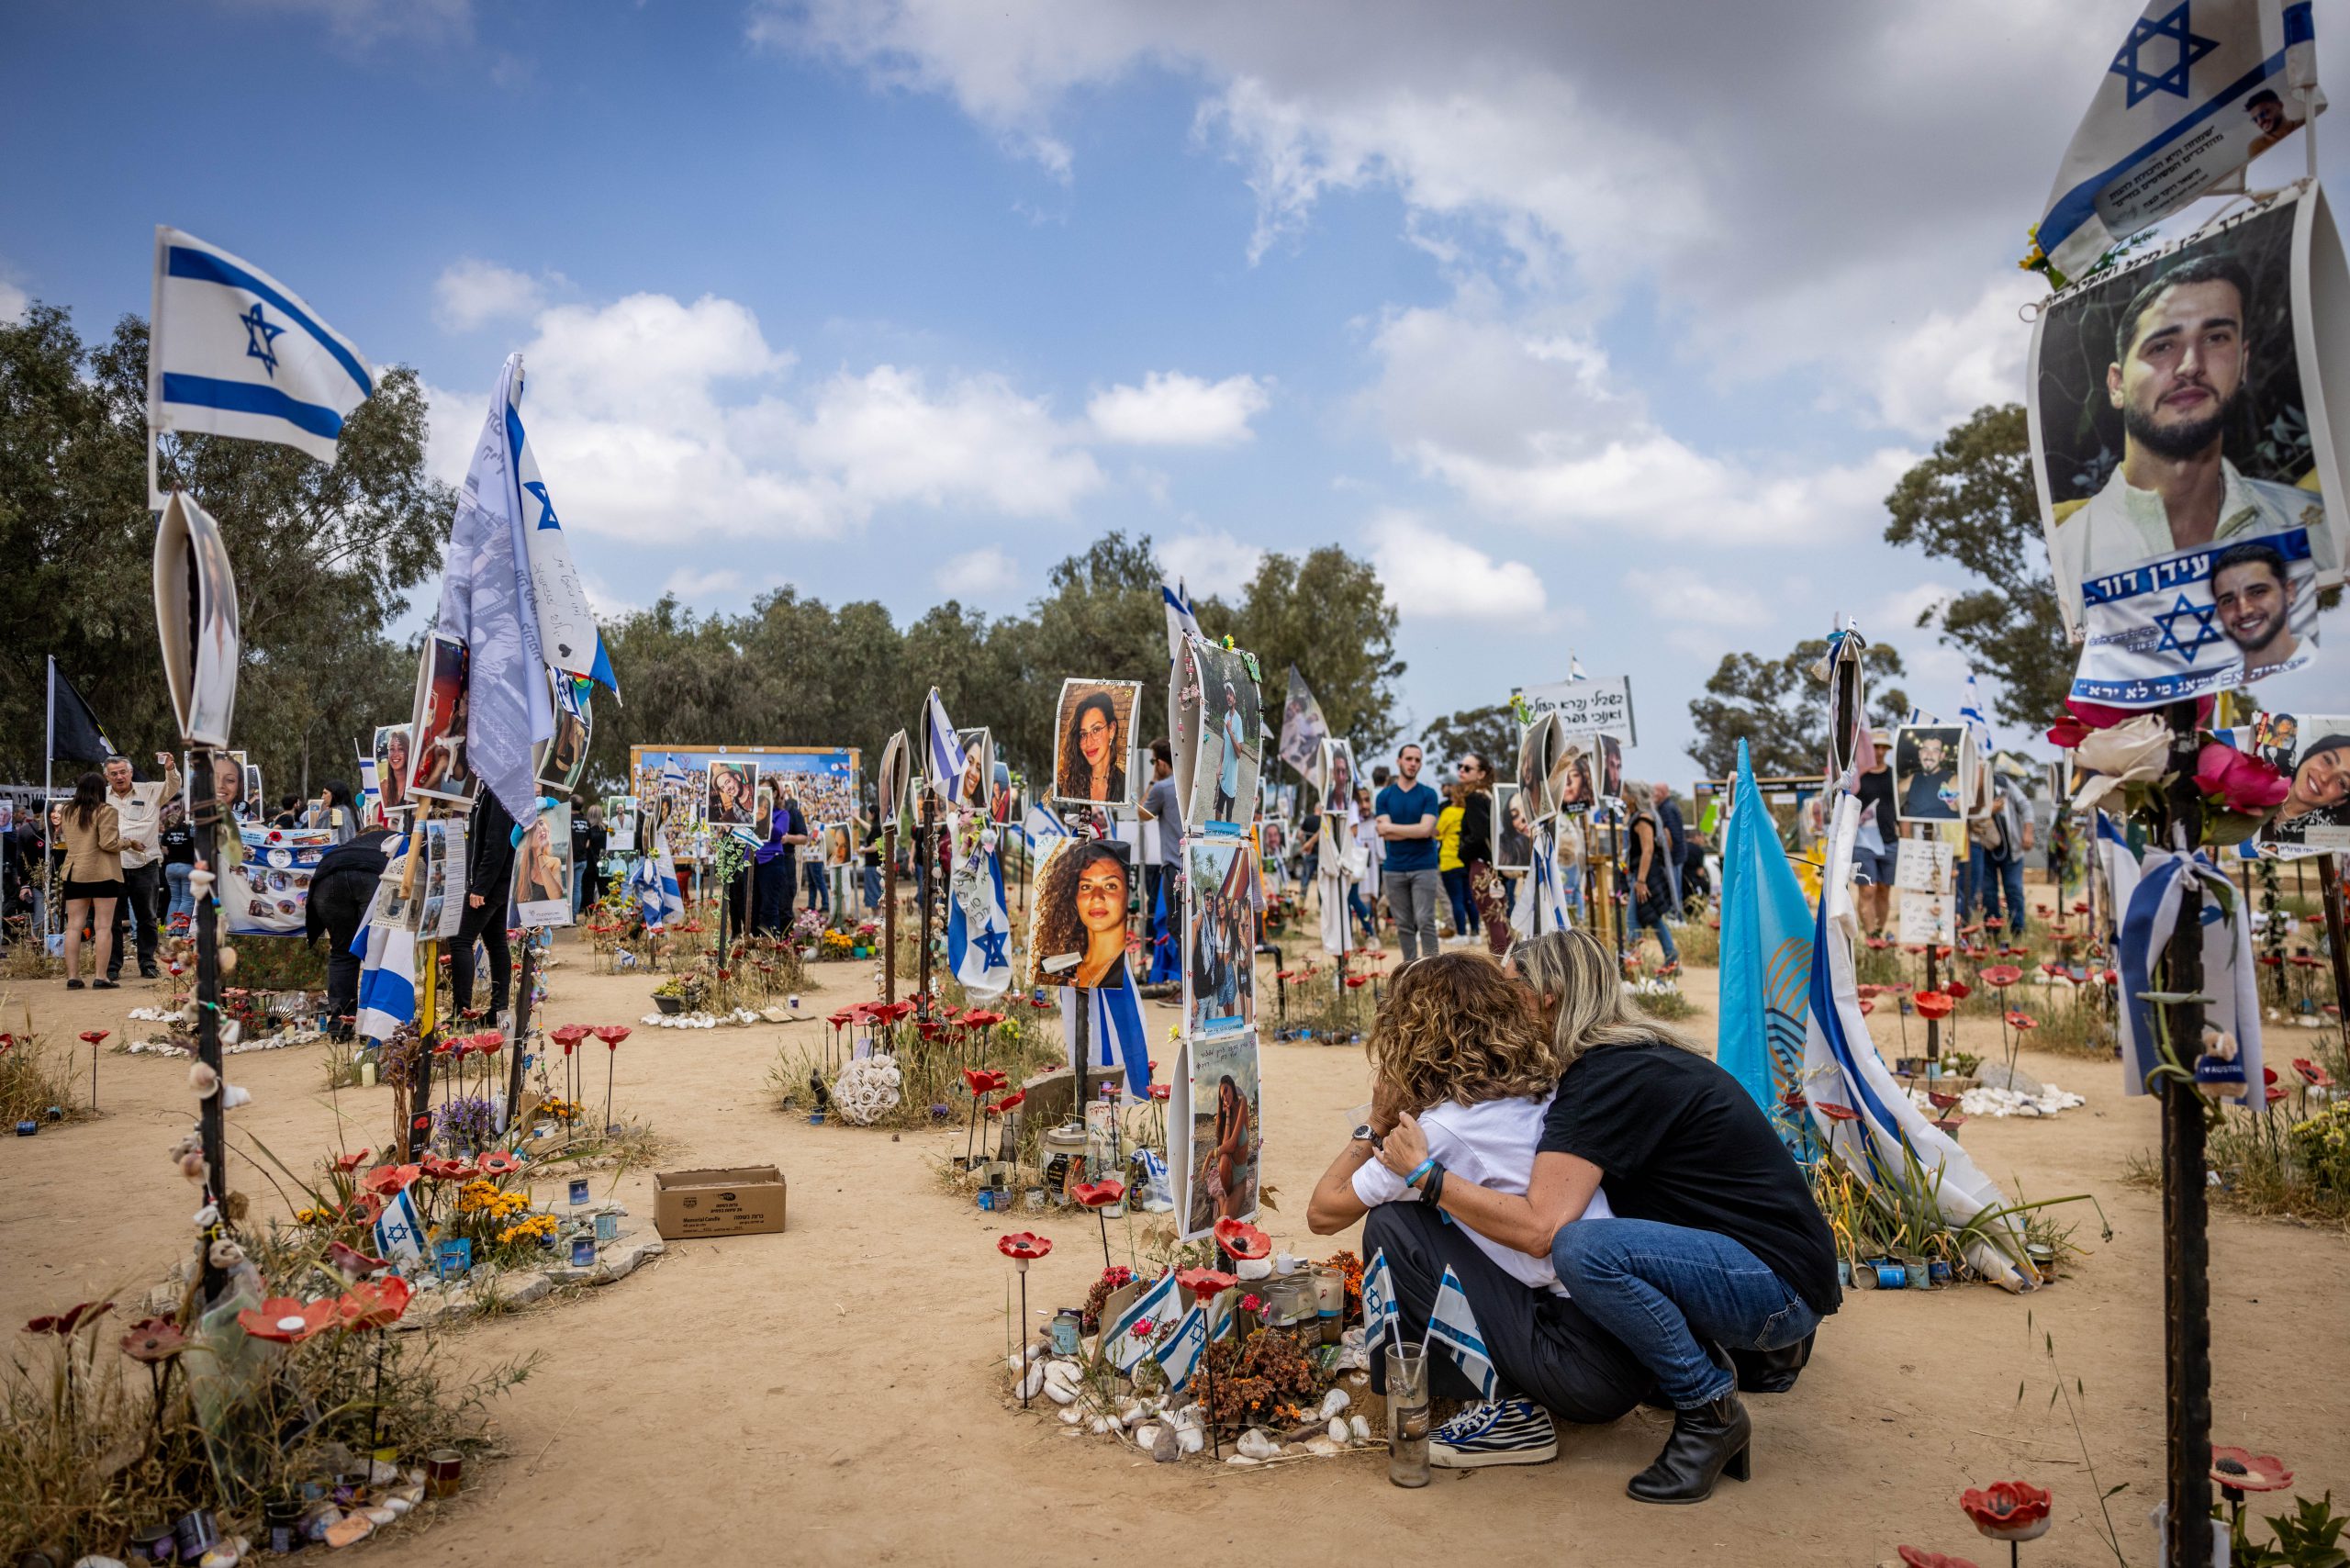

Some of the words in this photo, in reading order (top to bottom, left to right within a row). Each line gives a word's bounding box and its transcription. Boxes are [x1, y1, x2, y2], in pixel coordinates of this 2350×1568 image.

[2149, 554, 2210, 593] עידן
[2098, 571, 2137, 597] דור
[2124, 680, 2148, 700] לא
[2155, 682, 2172, 696] מי
[1561, 698, 1587, 711] נברא
[1591, 689, 1623, 707] בשבילי
[1563, 711, 1587, 723] עפר
[1591, 709, 1621, 724] ואנוכי
